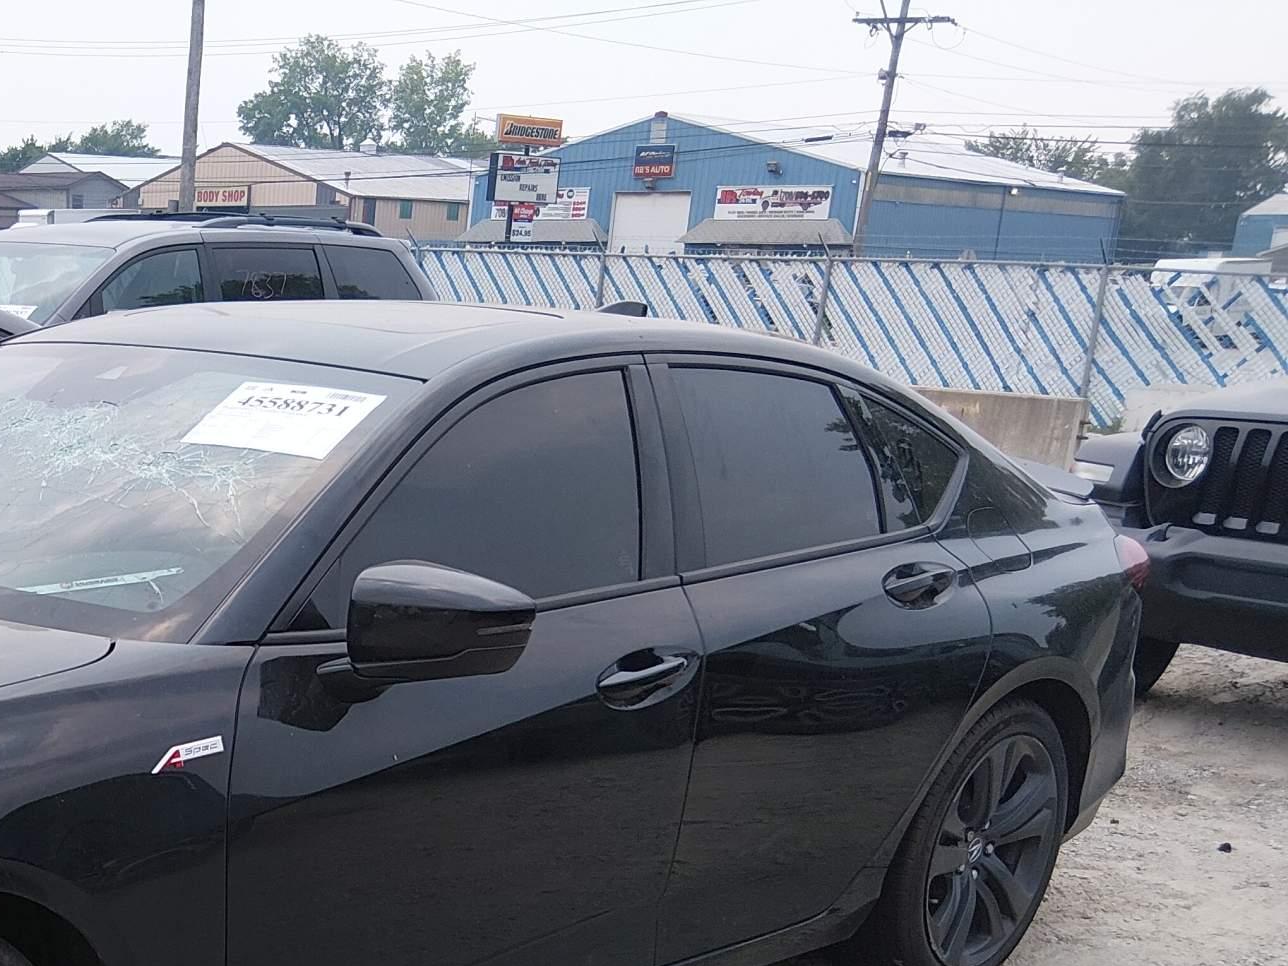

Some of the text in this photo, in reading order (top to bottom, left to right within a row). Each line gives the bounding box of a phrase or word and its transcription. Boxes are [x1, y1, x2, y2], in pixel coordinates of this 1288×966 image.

[504, 122, 559, 139] BRIDGESTONE
[651, 165, 671, 173] AUTO
[519, 183, 538, 193] REPAIRS
[197, 190, 245, 202] BODY SHOP
[512, 228, 532, 237] $24.95
[238, 395, 350, 417] 45588731
